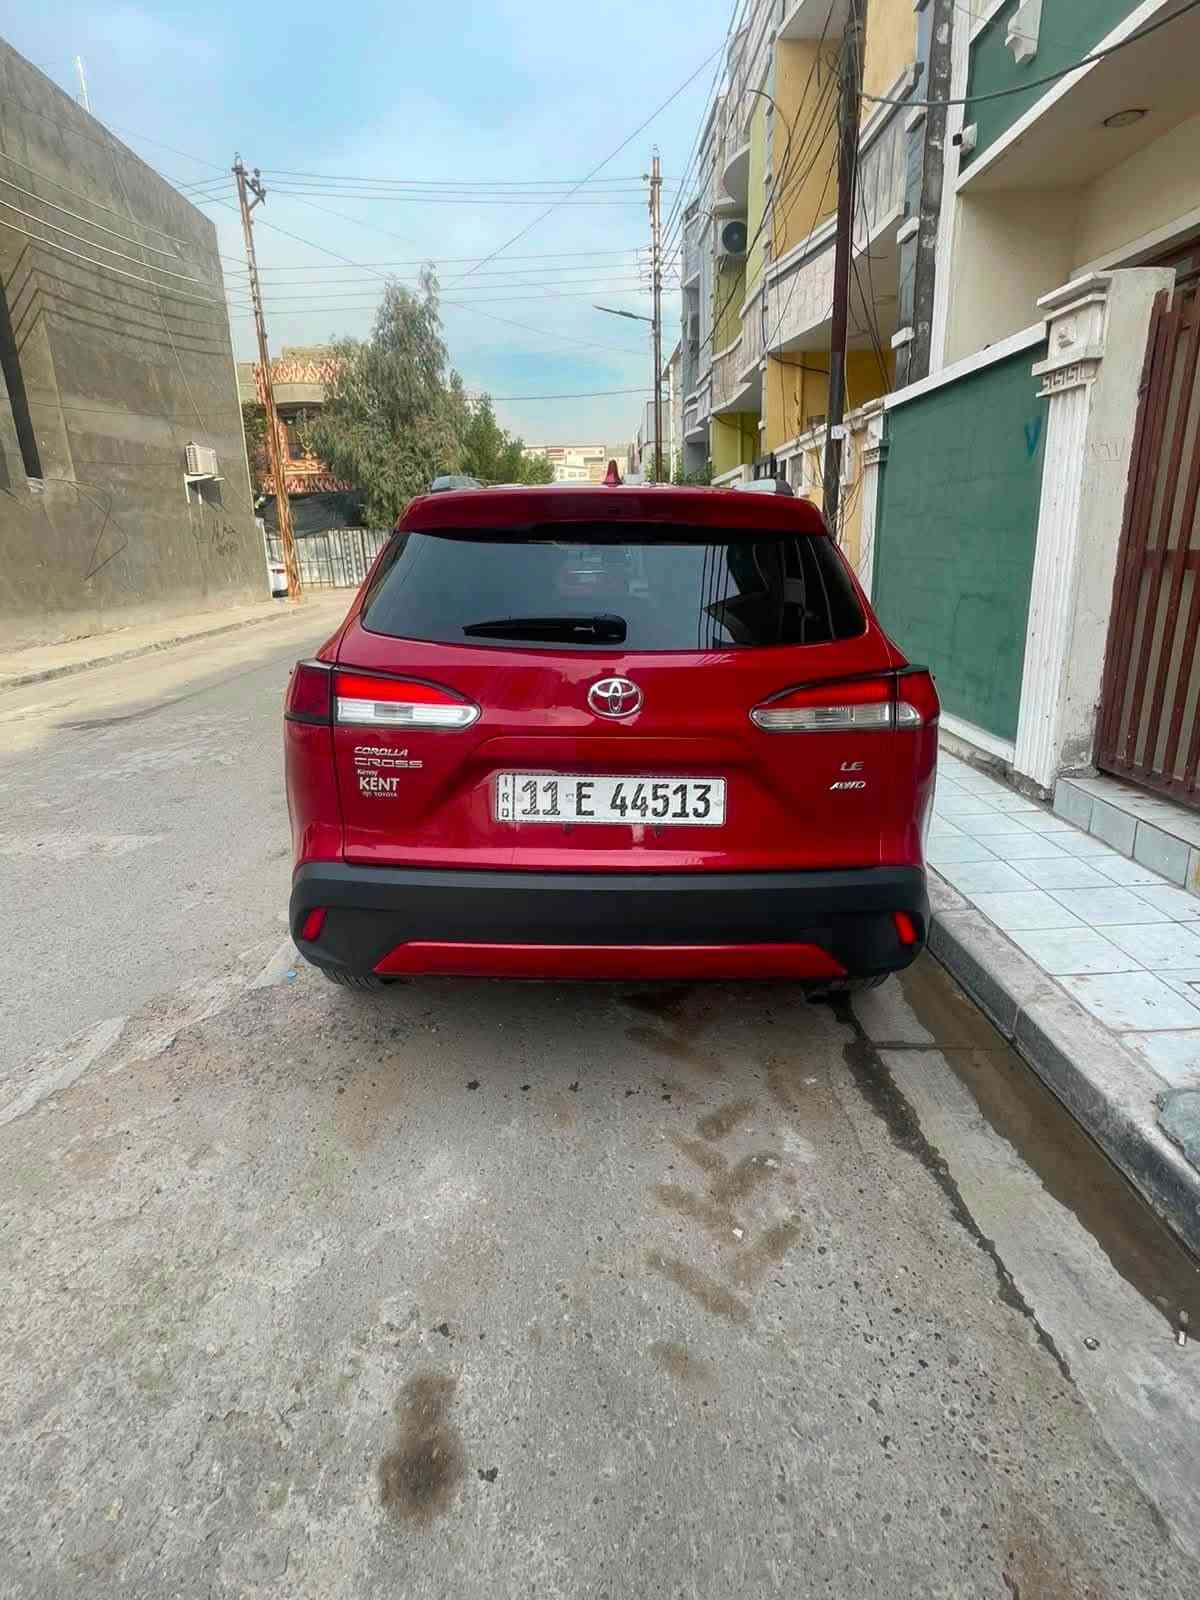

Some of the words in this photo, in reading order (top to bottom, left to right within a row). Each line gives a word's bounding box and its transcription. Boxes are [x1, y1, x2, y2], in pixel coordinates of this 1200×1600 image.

[353, 746, 409, 757] COROLLA
[353, 757, 424, 769] CROSS
[840, 761, 865, 771] LE
[359, 776, 400, 791] KENT
[830, 780, 867, 790] AWD
[521, 779, 561, 816] 11
[575, 782, 595, 816] E
[609, 782, 712, 818] 44513
